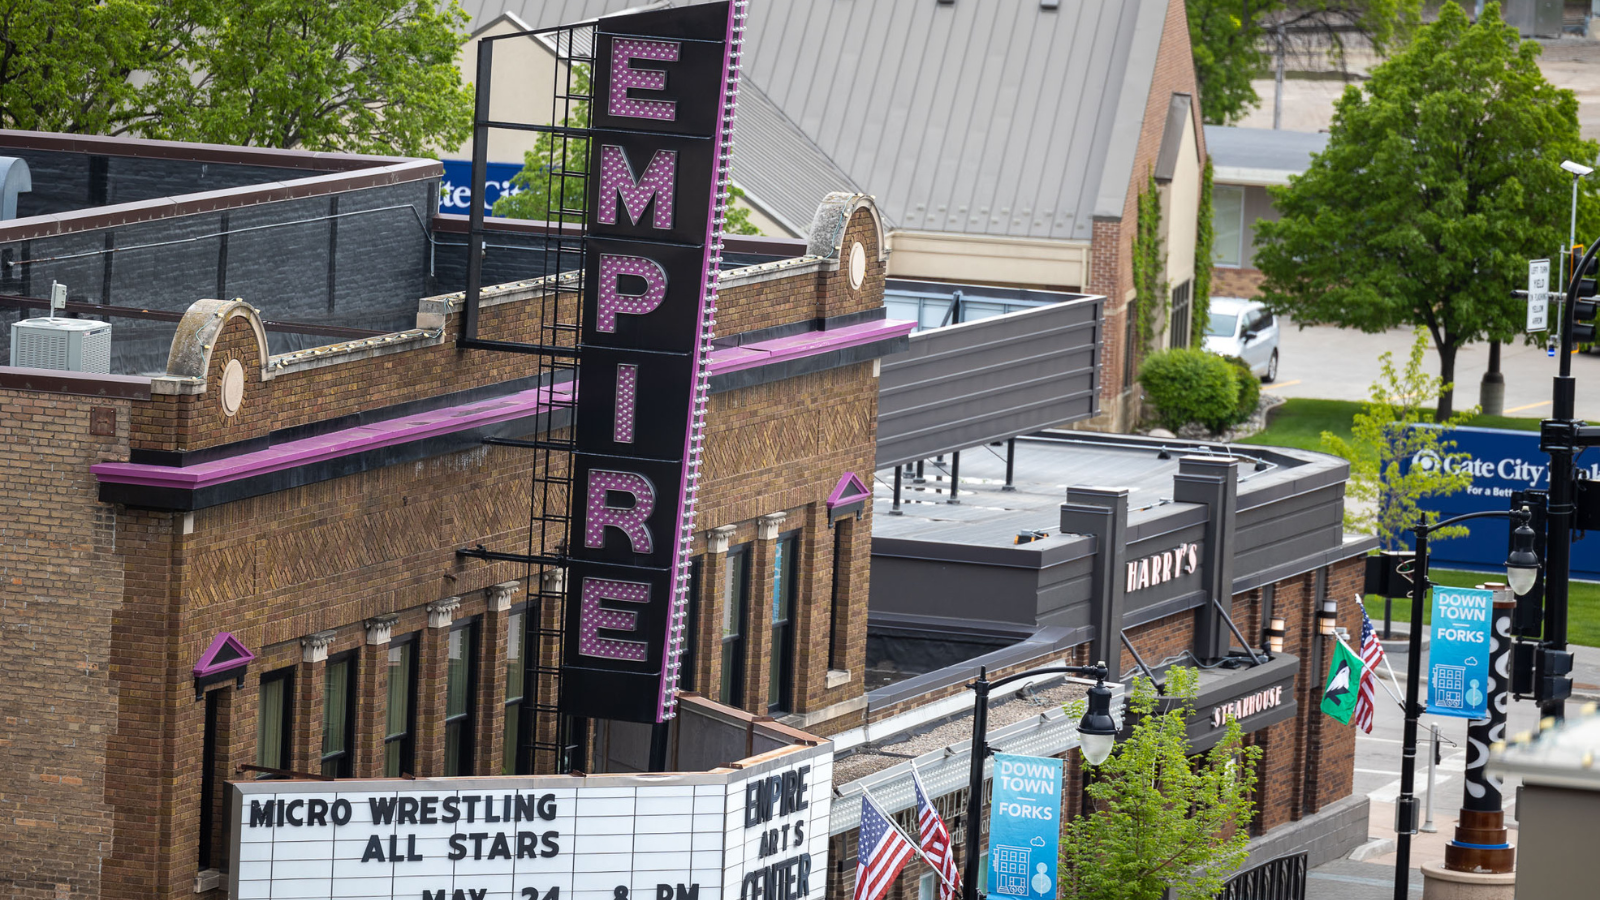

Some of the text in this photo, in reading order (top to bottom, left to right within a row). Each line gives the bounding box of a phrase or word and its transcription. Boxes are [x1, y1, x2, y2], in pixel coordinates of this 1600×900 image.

[577, 37, 682, 662] EMPIRE
[1443, 456, 1495, 478] Gate
[1498, 458, 1545, 487] City
[1467, 485, 1483, 495] For
[1484, 487, 1491, 496] a
[1493, 486, 1522, 498] Bett
[1126, 543, 1198, 593] HARRY'S
[1438, 606, 1486, 622] TOWN
[1439, 593, 1487, 608] DOWN
[1437, 628, 1485, 643] FORKS
[1211, 685, 1282, 728] STEAKHOUSE
[1000, 776, 1054, 795] TOWN
[1001, 761, 1055, 780] DOWN
[249, 793, 557, 828] MICRO WRESTLING
[745, 764, 811, 829] EMPIRE
[999, 802, 1053, 821] FORKS
[361, 831, 560, 863] ALL STARS
[741, 852, 812, 900] CENTER
